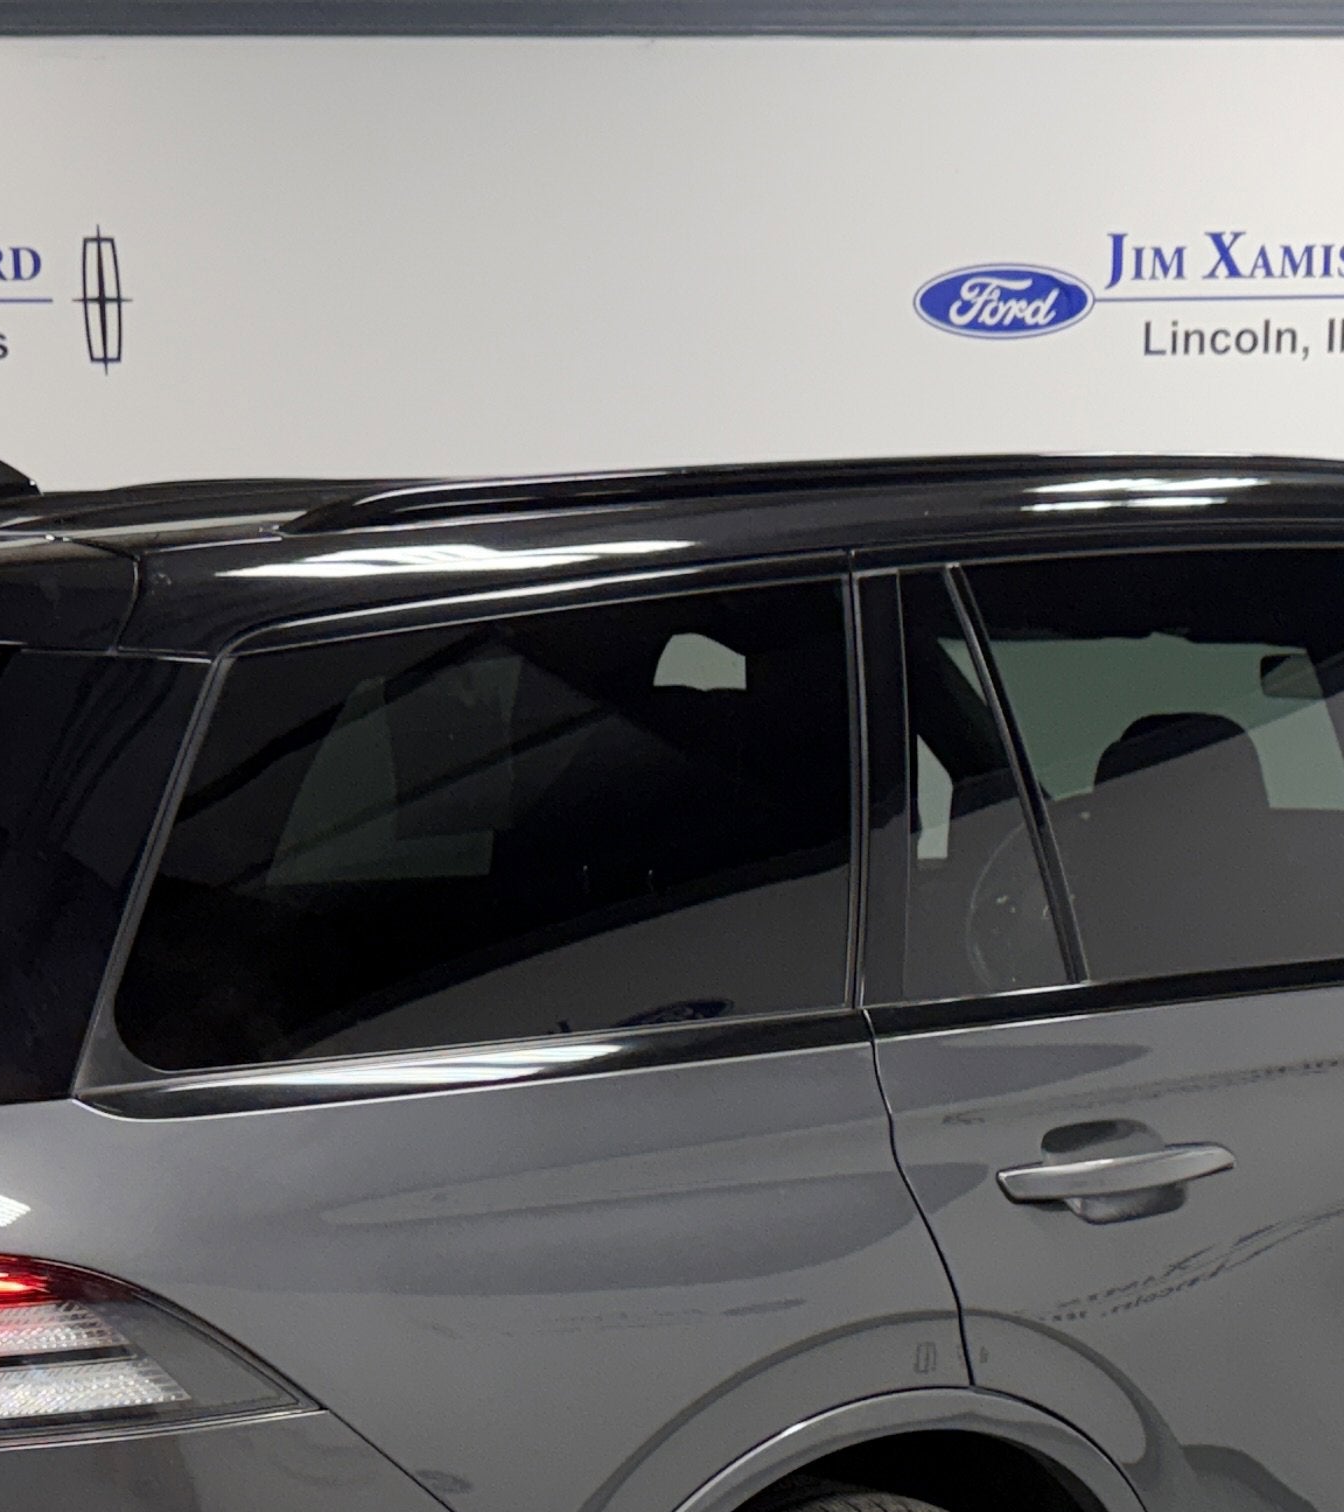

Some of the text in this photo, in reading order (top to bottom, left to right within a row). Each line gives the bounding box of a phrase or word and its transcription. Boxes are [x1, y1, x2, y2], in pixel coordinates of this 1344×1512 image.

[1105, 233, 1187, 290] JIM
[948, 277, 1056, 326] Ford
[1144, 320, 1310, 361] Lincoln,
